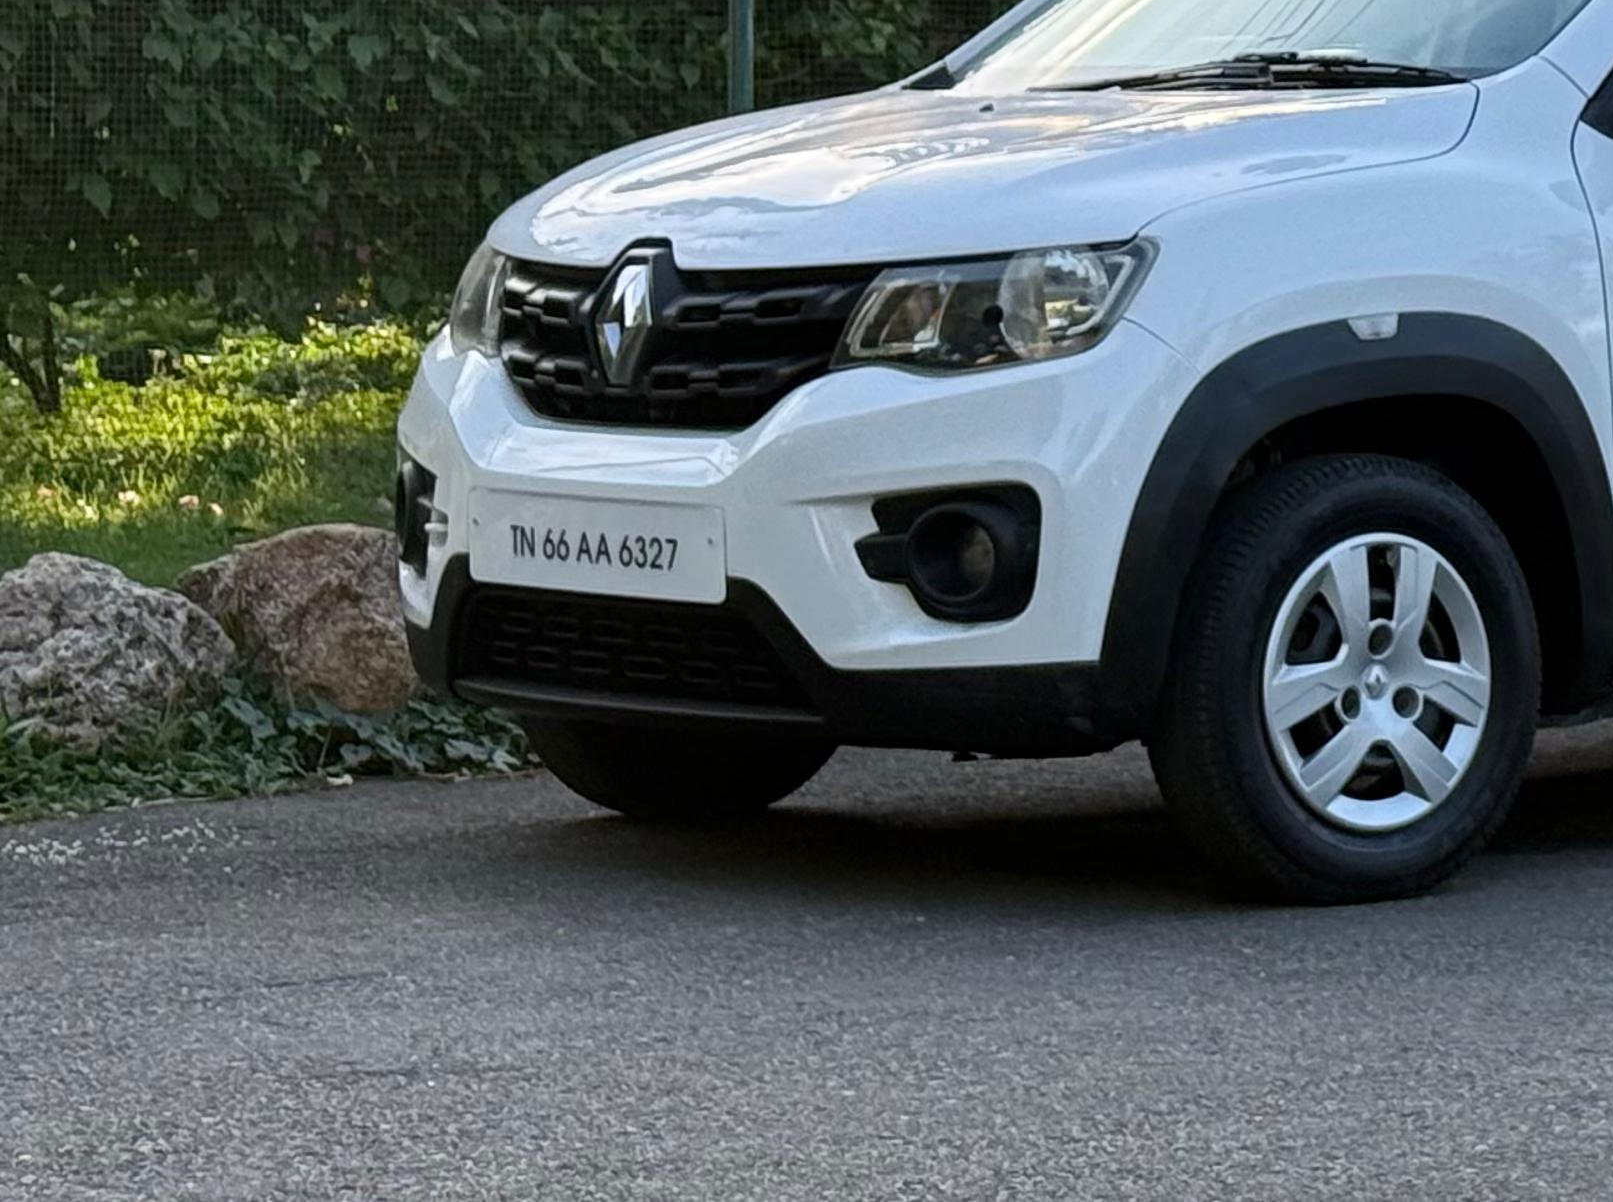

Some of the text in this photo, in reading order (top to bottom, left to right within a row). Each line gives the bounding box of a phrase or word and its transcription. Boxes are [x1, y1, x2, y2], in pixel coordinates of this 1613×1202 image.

[510, 524, 678, 571] TN 66 AA 6327
